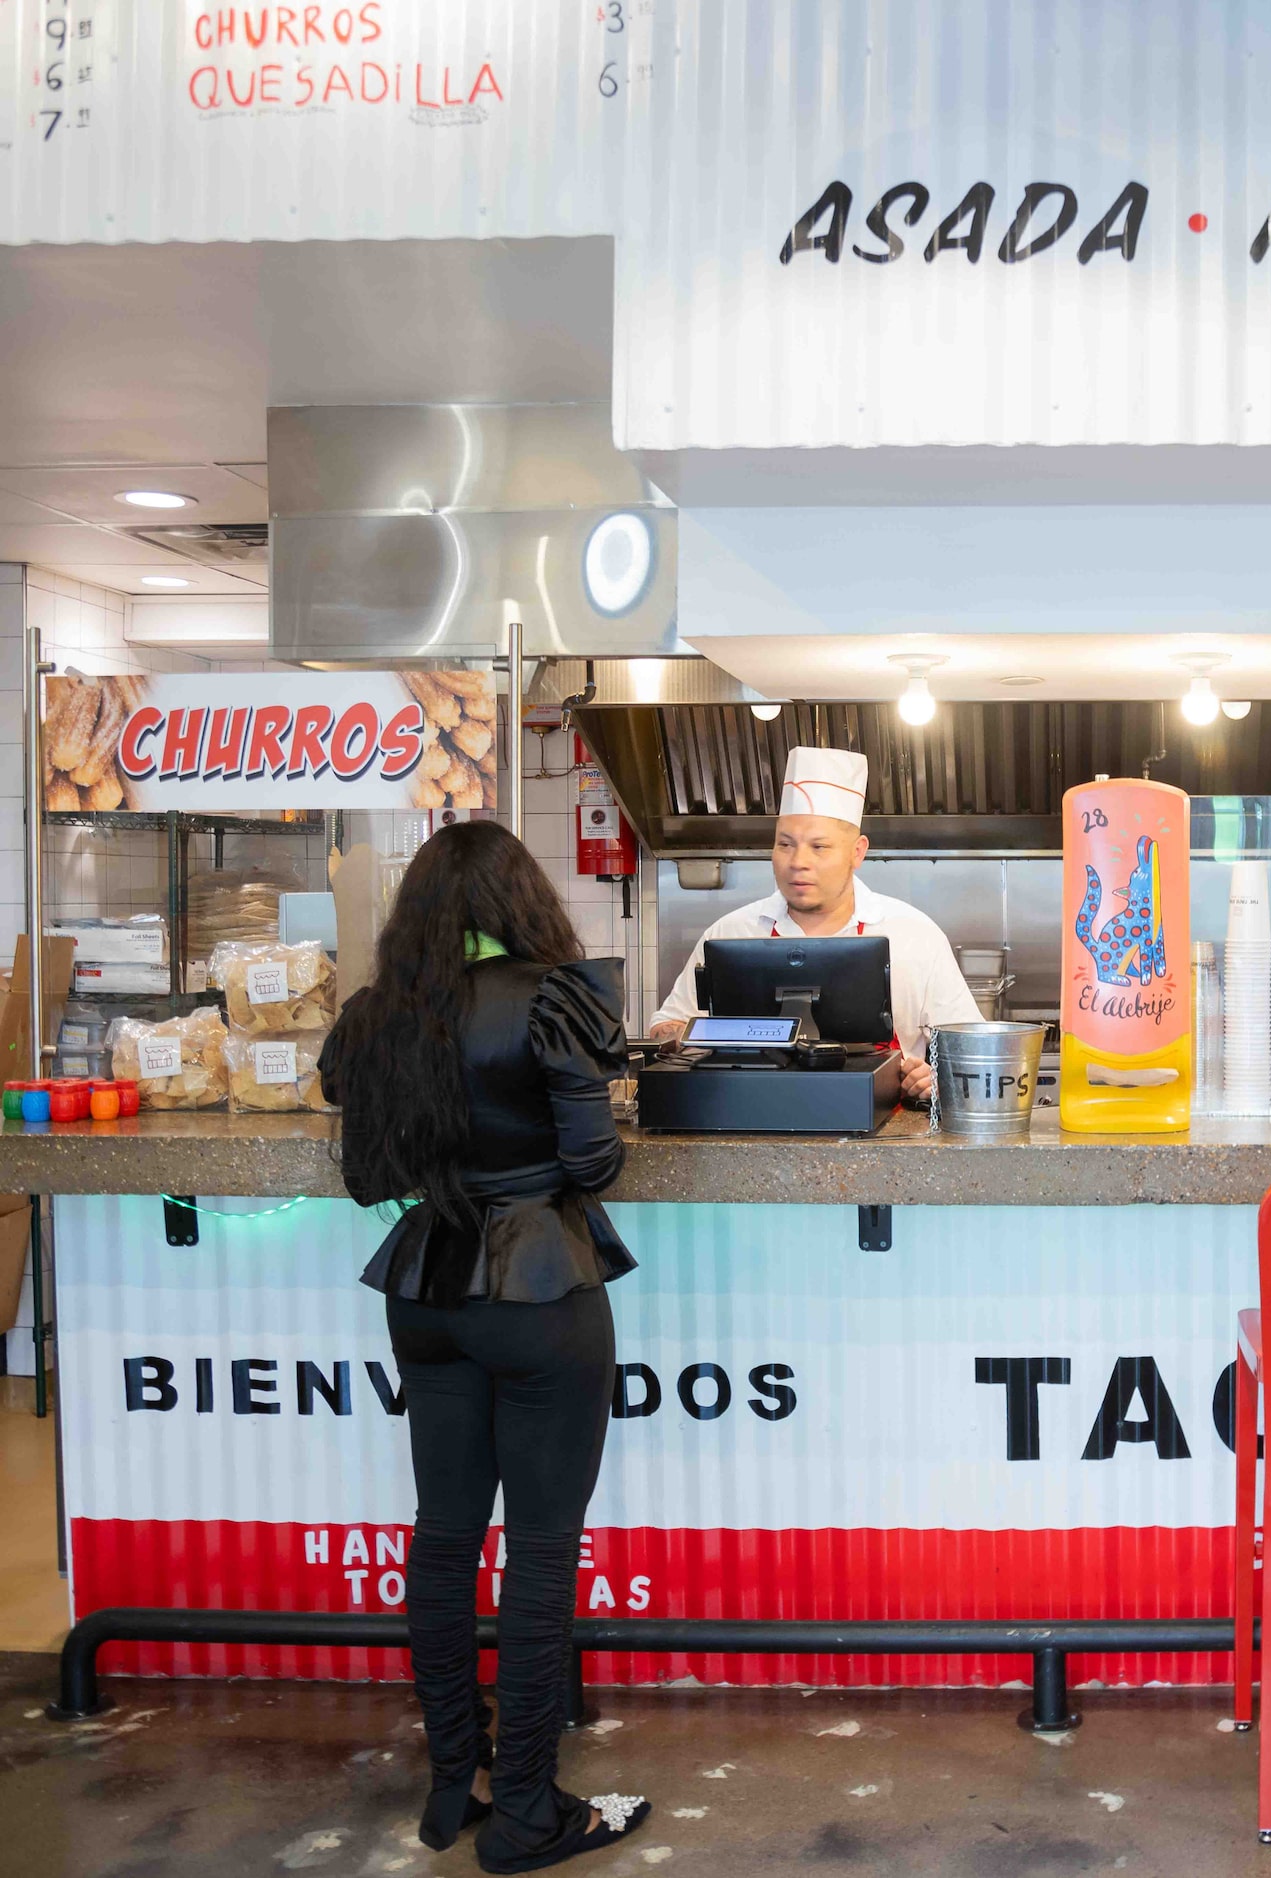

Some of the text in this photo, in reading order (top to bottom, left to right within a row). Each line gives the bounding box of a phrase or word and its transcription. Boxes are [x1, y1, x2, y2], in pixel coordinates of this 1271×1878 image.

[195, 3, 382, 49] CHURROS
[780, 181, 1149, 265] ASADA
[118, 701, 424, 783] CHURROS
[1082, 808, 1109, 834] 28
[1079, 985, 1098, 1013] El
[123, 1356, 798, 1421] BIENVDOS
[304, 1529, 595, 1569] HANE
